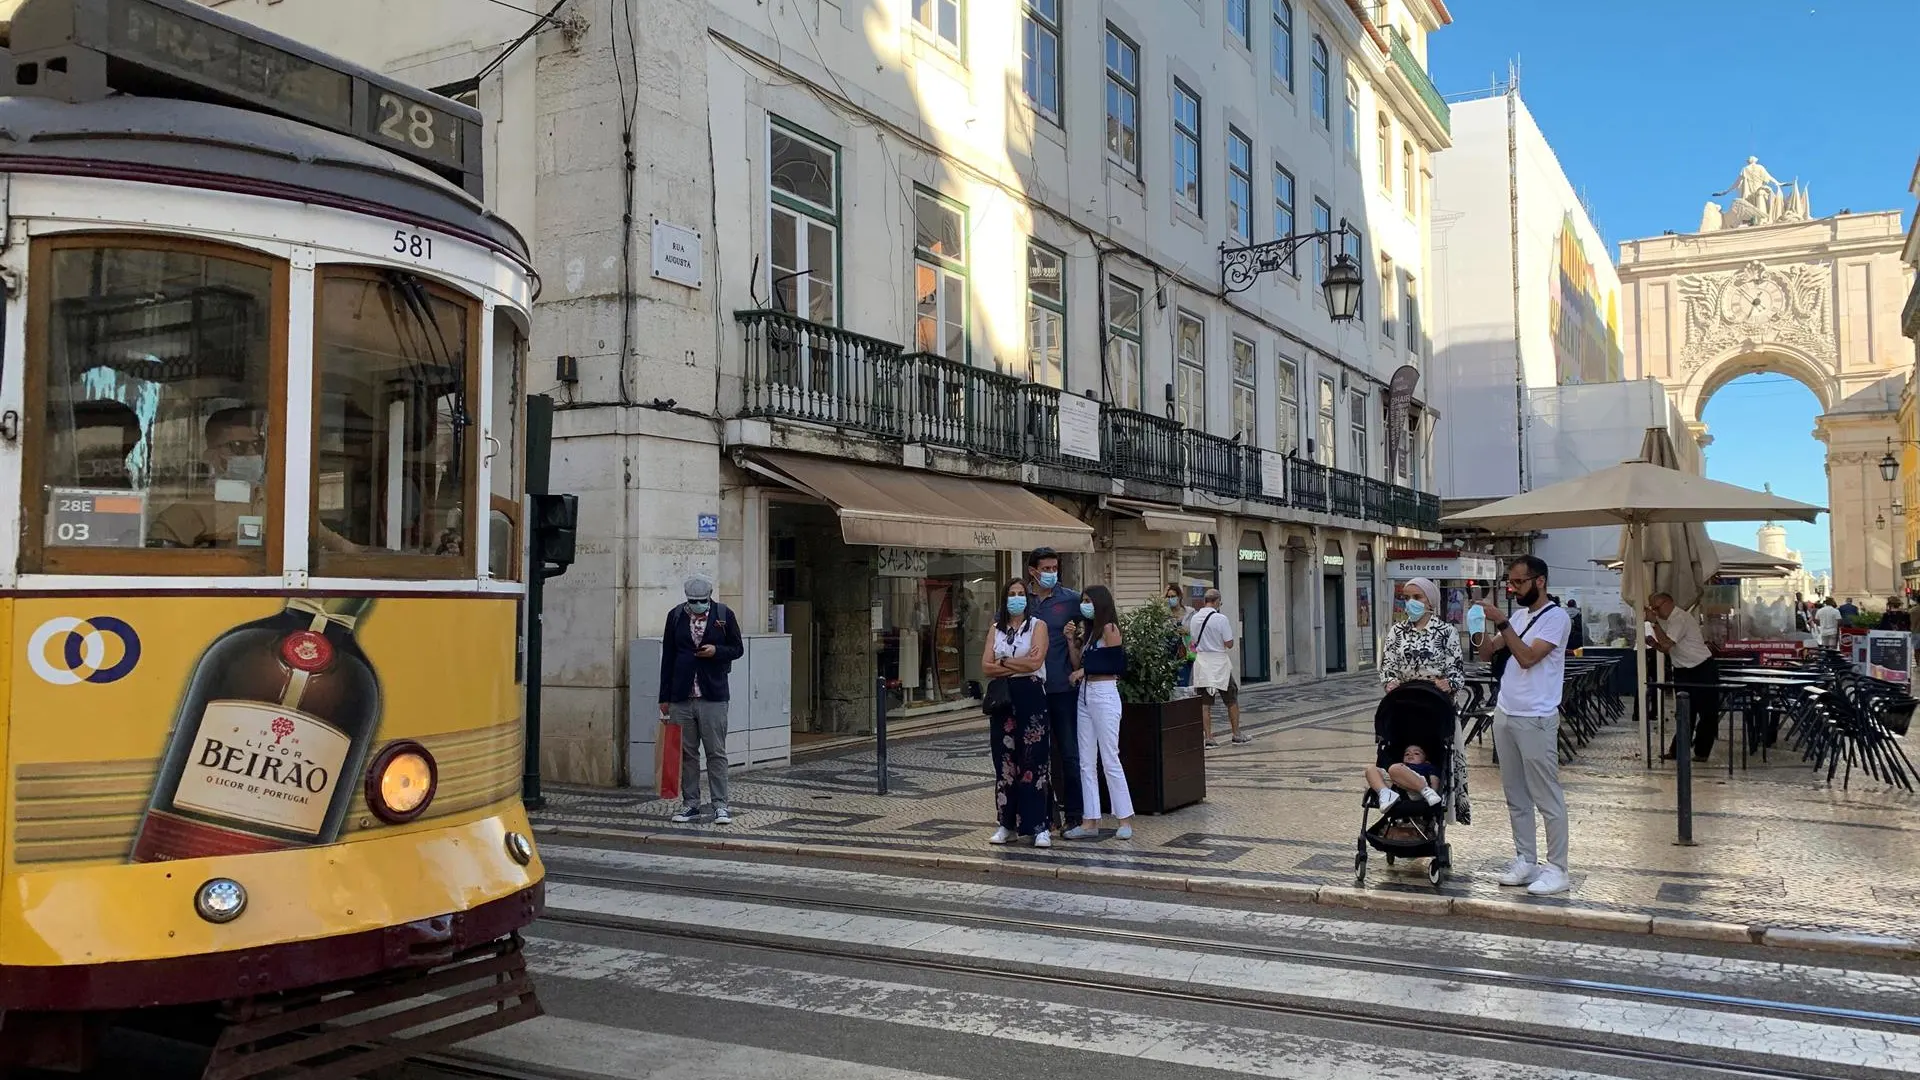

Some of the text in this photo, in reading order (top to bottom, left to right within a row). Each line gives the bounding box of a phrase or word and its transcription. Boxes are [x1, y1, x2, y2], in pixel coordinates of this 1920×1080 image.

[379, 93, 435, 149] 28
[393, 230, 432, 260] 581
[672, 242, 685, 253] RUA
[664, 254, 691, 268] AUGUSTA
[59, 499, 92, 512] 28E
[57, 523, 90, 540] 03
[1239, 549, 1267, 561] SPRINGFIELD
[1399, 563, 1449, 571] Restaurante
[246, 739, 302, 759] LICOR
[197, 737, 328, 793] BEIRÃO
[206, 775, 309, 805] O LICOR DE PORTUGAL
